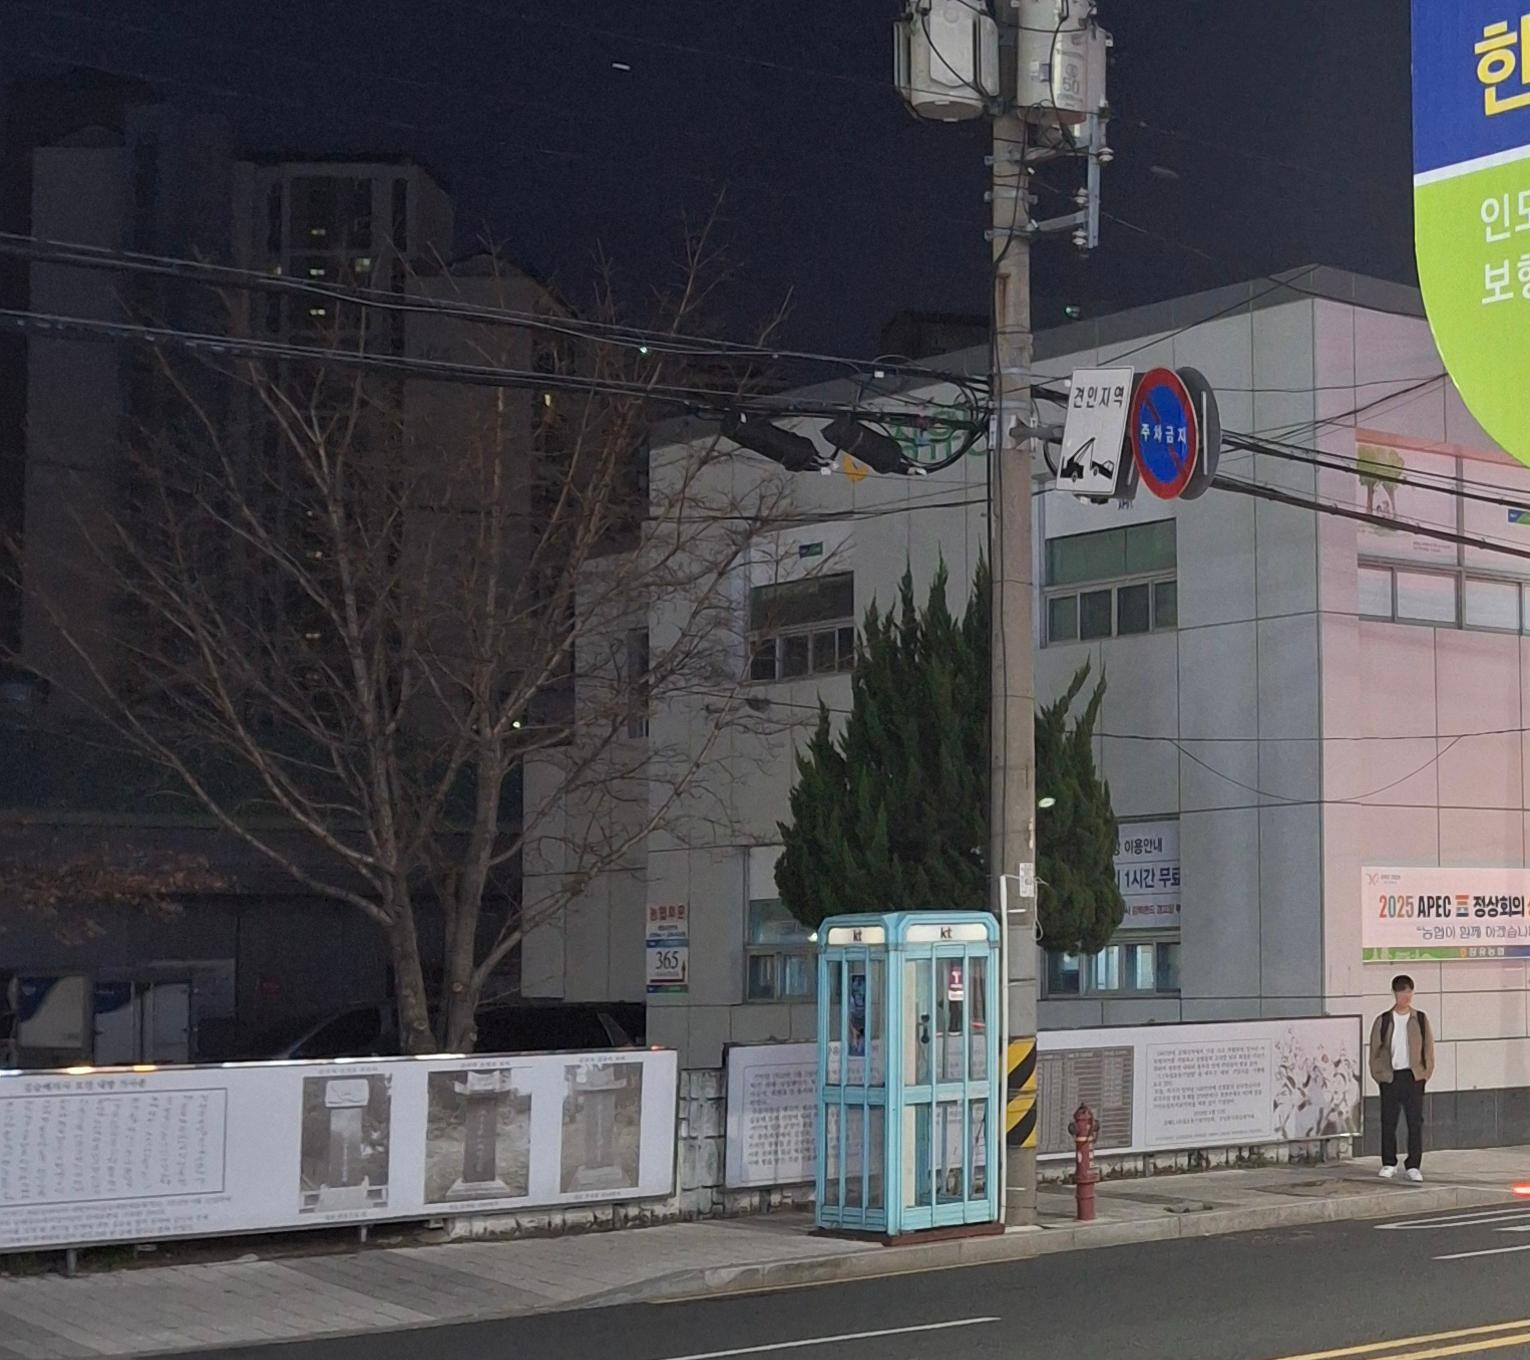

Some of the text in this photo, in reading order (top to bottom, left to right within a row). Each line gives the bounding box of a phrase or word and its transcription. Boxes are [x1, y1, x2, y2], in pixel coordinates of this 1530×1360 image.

[1074, 385, 1125, 409] 견인지역
[1141, 423, 1187, 444] 주차금지
[1124, 837, 1163, 856] 이용안내
[1125, 868, 1156, 889] 1시간
[1379, 895, 1414, 918] 2025
[1417, 895, 1452, 918] APEC
[1473, 895, 1525, 918] 정상회의
[853, 929, 863, 942] kt
[940, 927, 953, 940] kt
[655, 949, 679, 970] 365
